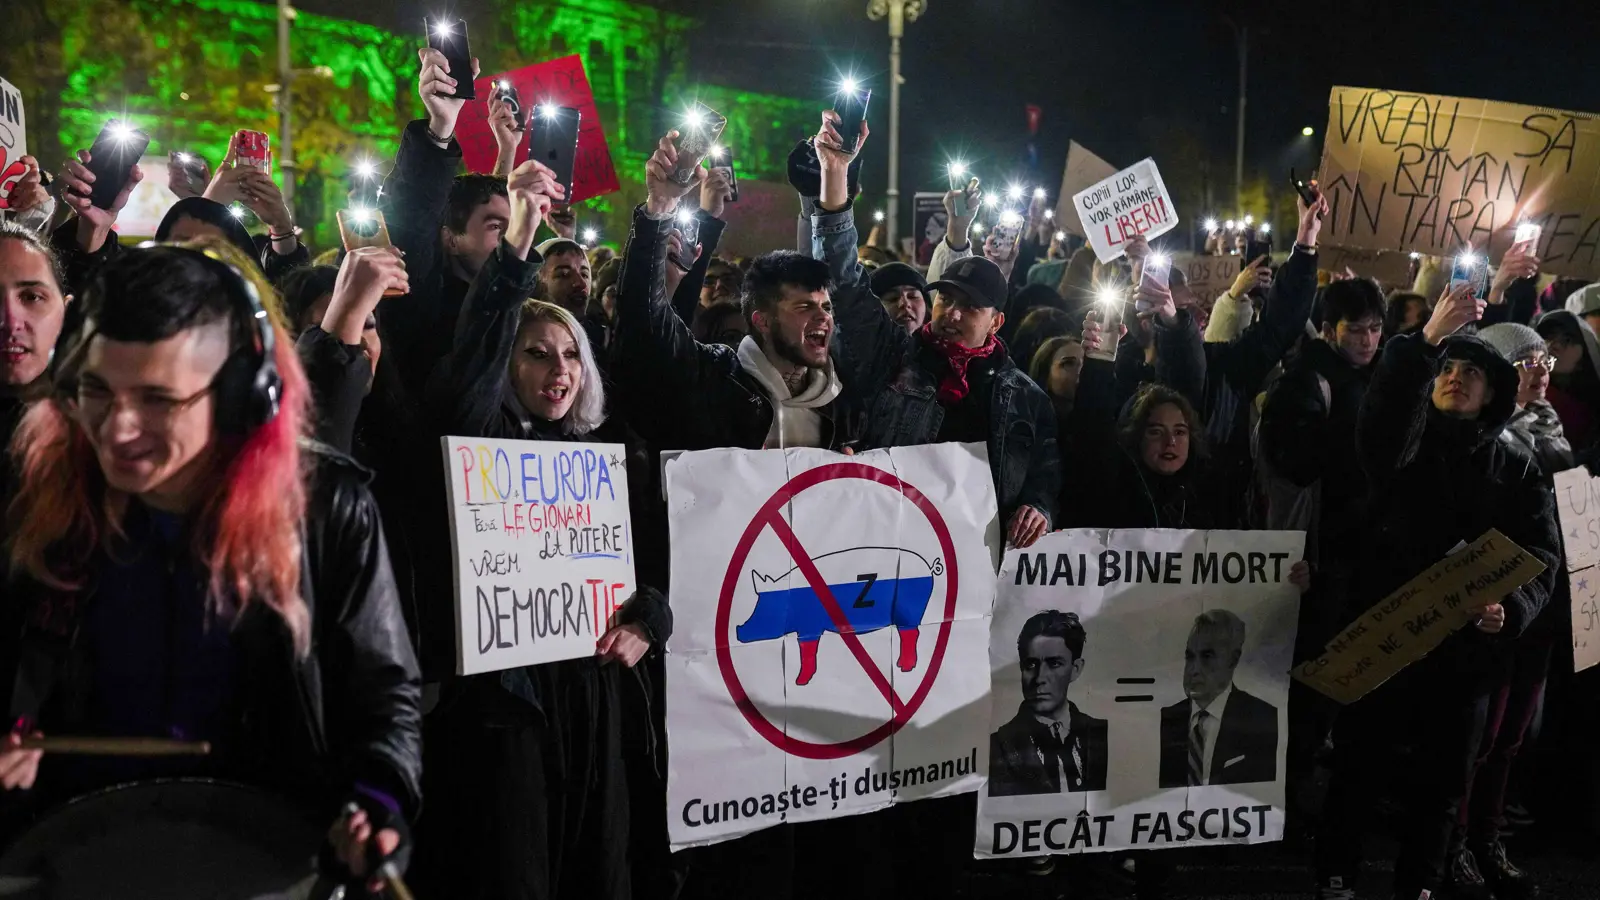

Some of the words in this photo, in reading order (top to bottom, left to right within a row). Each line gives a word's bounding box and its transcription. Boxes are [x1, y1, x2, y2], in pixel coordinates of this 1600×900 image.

[1339, 90, 1460, 151] VREAU
[1116, 172, 1138, 193] LOR
[1327, 174, 1388, 235] ÎN
[1088, 207, 1113, 225] VOR
[457, 445, 511, 504] PRO
[520, 449, 615, 504] EUROPA
[502, 503, 591, 535] LEGIONARI
[469, 549, 521, 577] VREM
[1014, 552, 1087, 587] MAI
[1097, 549, 1183, 587] BINE
[1192, 551, 1290, 585] MORT
[852, 572, 878, 609] Z
[1378, 632, 1403, 656] NE
[1403, 602, 1445, 637] BAGĂ
[682, 772, 848, 827] Cunoaște-ți
[854, 747, 978, 798] dușmanul
[991, 809, 1115, 855] DECÂT
[1130, 804, 1272, 844] FASCIST
